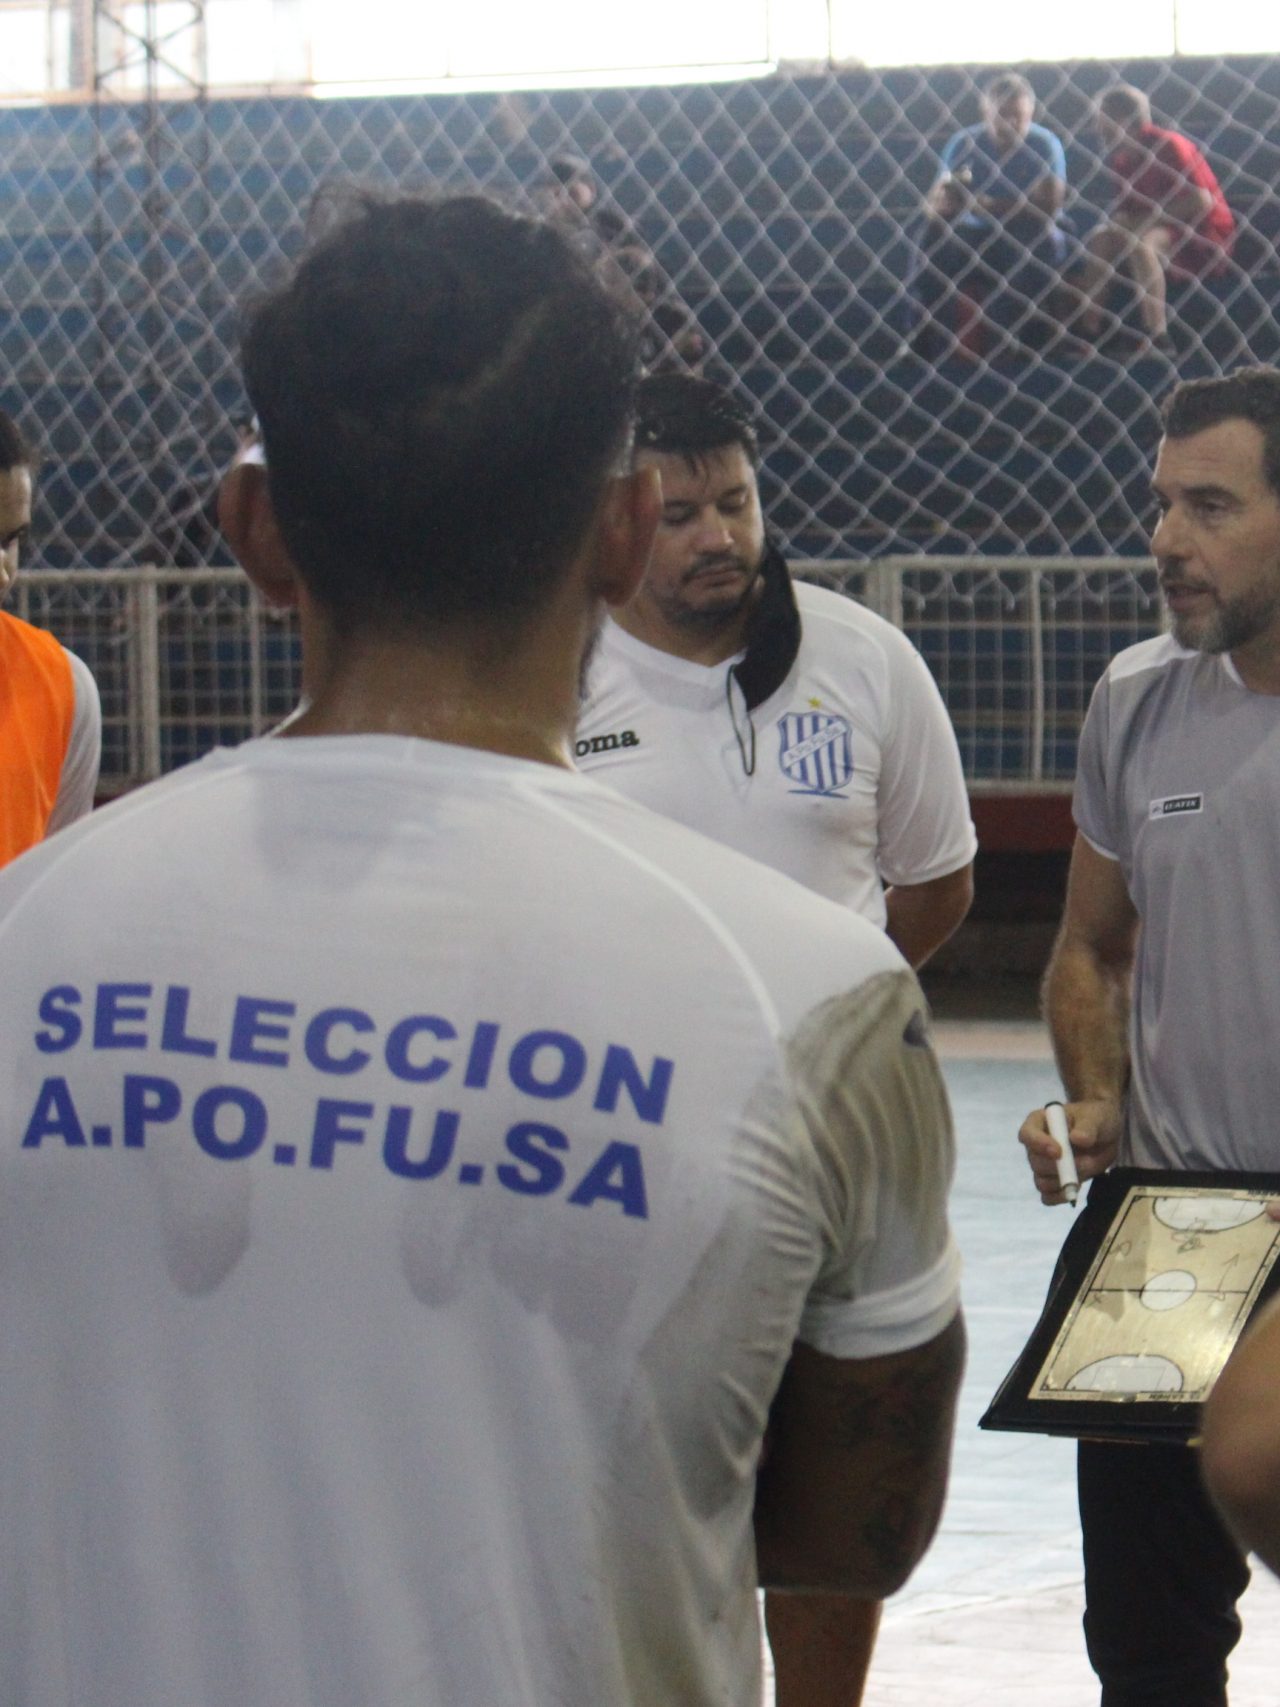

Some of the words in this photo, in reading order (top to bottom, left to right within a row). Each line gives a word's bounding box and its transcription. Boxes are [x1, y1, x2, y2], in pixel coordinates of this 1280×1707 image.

[575, 730, 640, 757] oma
[34, 983, 675, 1125] SELECCION
[21, 1073, 649, 1220] A.PO.FU.SA
